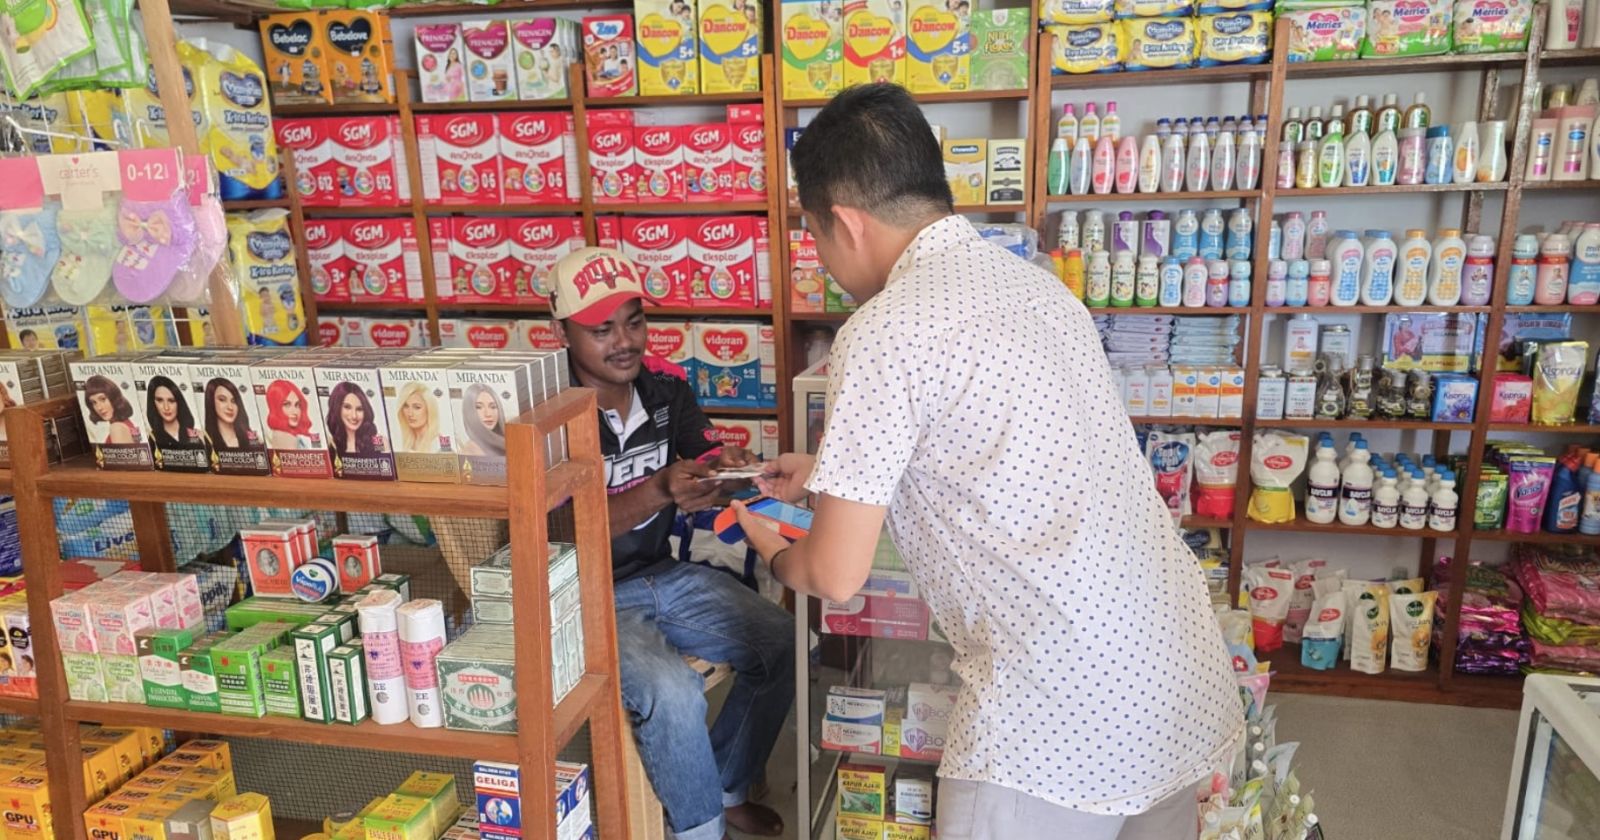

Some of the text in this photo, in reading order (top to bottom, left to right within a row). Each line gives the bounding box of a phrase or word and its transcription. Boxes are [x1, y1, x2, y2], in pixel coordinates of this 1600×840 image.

[1394, 6, 1430, 18] Merries
[1472, 7, 1508, 18] Merries
[1306, 20, 1342, 31] Merries
[272, 32, 308, 44] Bebelac
[329, 29, 369, 42] Bebelove
[420, 34, 457, 43] PRENAGEN
[517, 29, 552, 38] PRENAGEN
[470, 38, 504, 47] PRENAGEN
[951, 40, 969, 53] 5+
[679, 46, 695, 59] 5+
[741, 43, 757, 56] 5+
[825, 48, 840, 60] 3+
[343, 124, 371, 142] SGM
[450, 121, 478, 140] SGM
[516, 119, 545, 138] SGM
[283, 126, 312, 144] SGM
[595, 133, 622, 149] SGM
[644, 132, 670, 148] SGM
[693, 130, 719, 146] SGM
[670, 170, 683, 183] 1+
[305, 225, 327, 240] GM
[355, 225, 384, 242] SGM
[466, 223, 496, 241] SGM
[523, 224, 554, 242] SGM
[637, 224, 669, 242] SGM
[703, 223, 735, 242] SGM
[465, 251, 499, 262] Eksplor
[523, 252, 558, 262] Eksplor
[637, 253, 673, 263] Eksplor
[702, 252, 738, 263] Eksplor
[672, 269, 686, 285] 1+
[736, 269, 751, 285] 1+
[373, 327, 407, 340] vidoran
[470, 330, 505, 342] vidoran
[705, 335, 744, 346] vidoran
[78, 365, 123, 376] MIRANDA
[138, 366, 183, 377] MIRANDA
[196, 367, 242, 378] MIRANDA
[258, 369, 305, 380] MIRANDA
[322, 371, 371, 382] MIRANDA
[389, 370, 439, 382] MIRANDA
[456, 372, 505, 384] MIRANDA
[280, 452, 324, 461] PERMANENT
[373, 682, 387, 691] EE
[415, 692, 429, 701] EE
[476, 776, 517, 788] GELIGA
[5, 811, 34, 825] GPU
[92, 828, 119, 840] GPU
